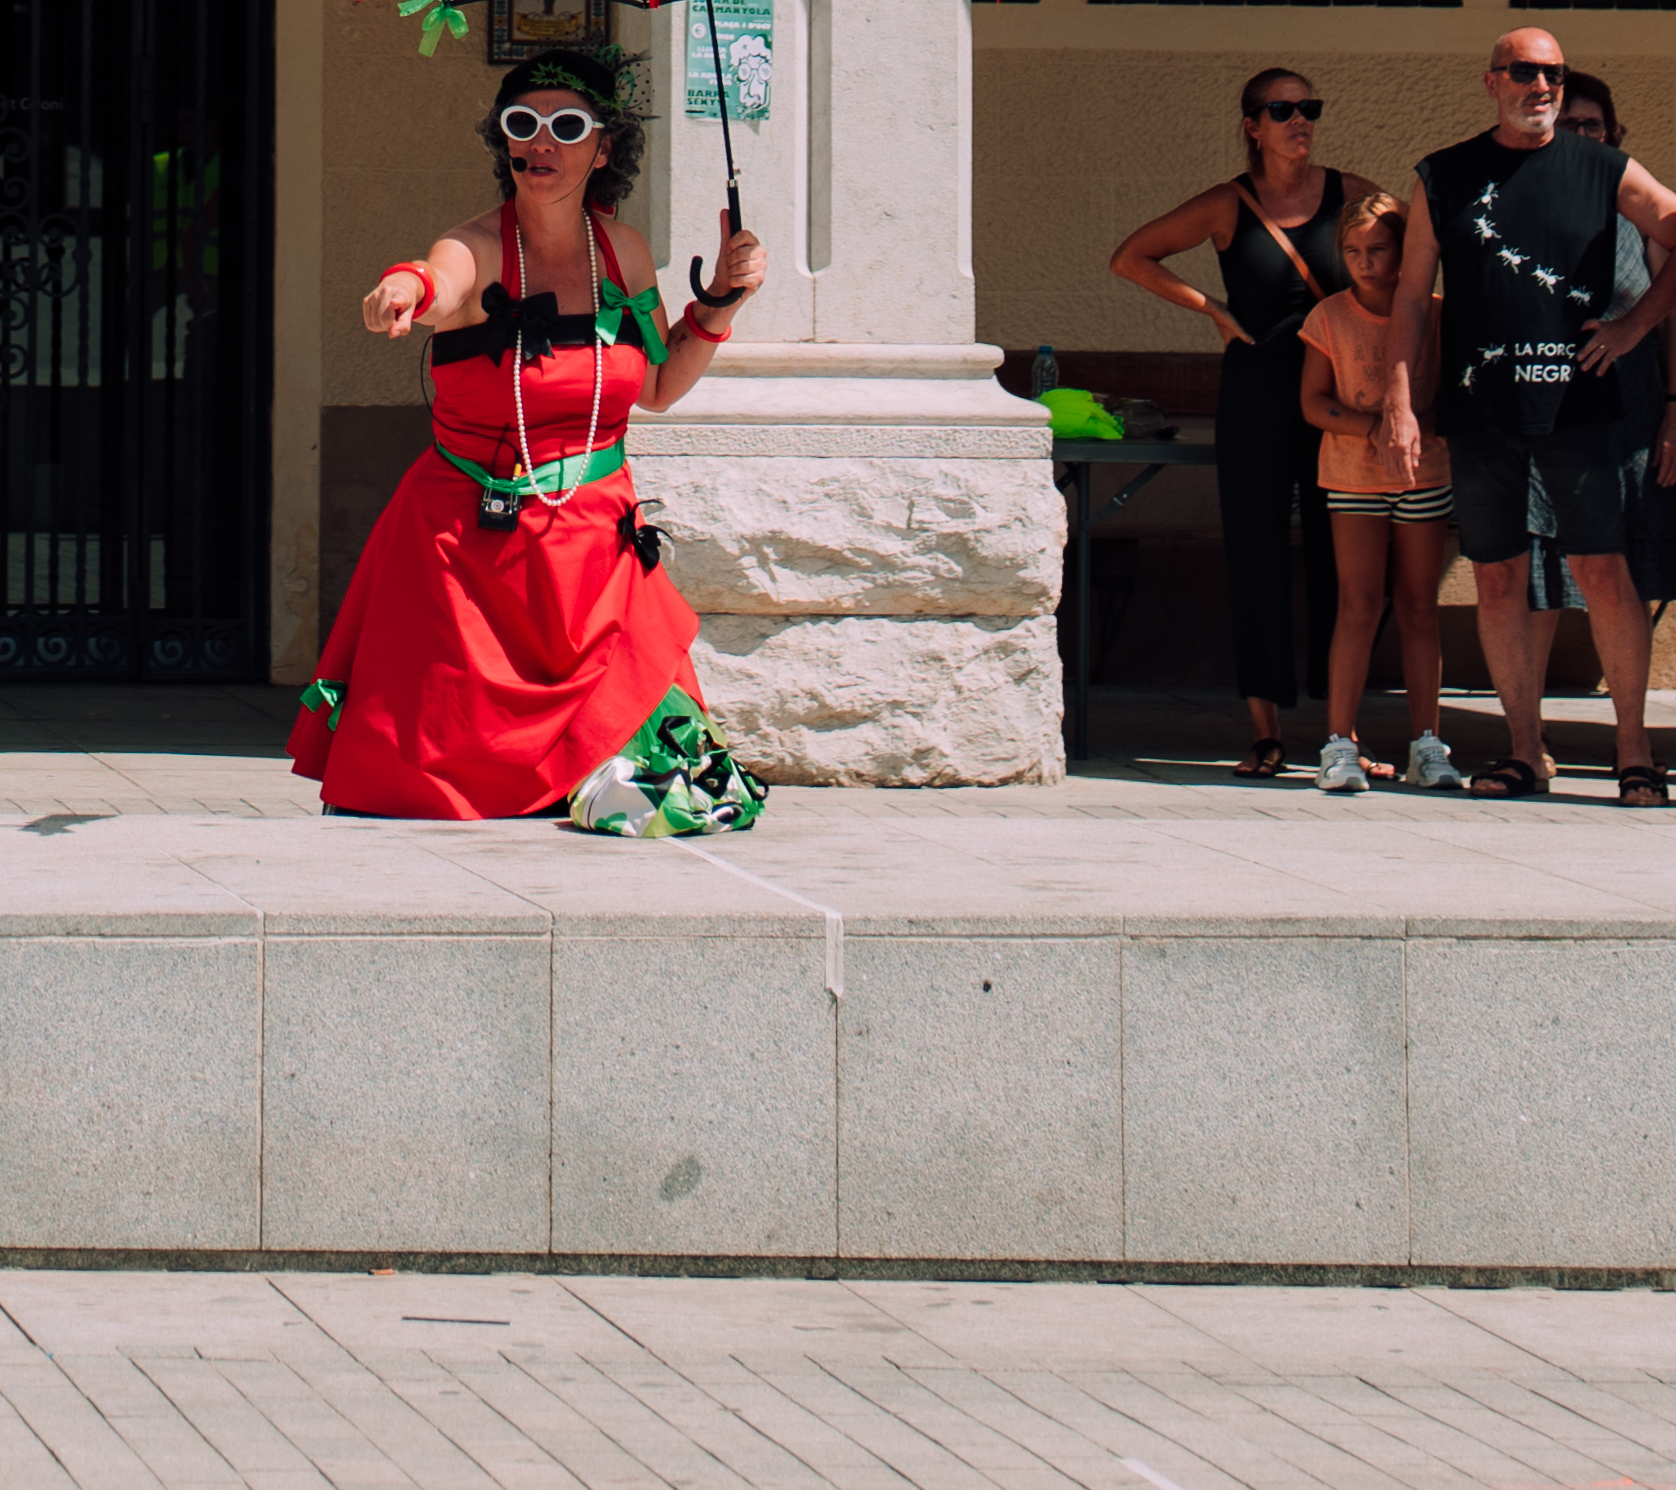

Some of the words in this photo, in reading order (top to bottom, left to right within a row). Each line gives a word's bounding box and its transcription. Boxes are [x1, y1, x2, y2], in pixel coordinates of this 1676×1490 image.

[692, 5, 771, 16] CAMANYOLA
[1514, 342, 1534, 356] LA
[1537, 342, 1576, 359] FORÇ
[1514, 364, 1574, 382] NEGR
